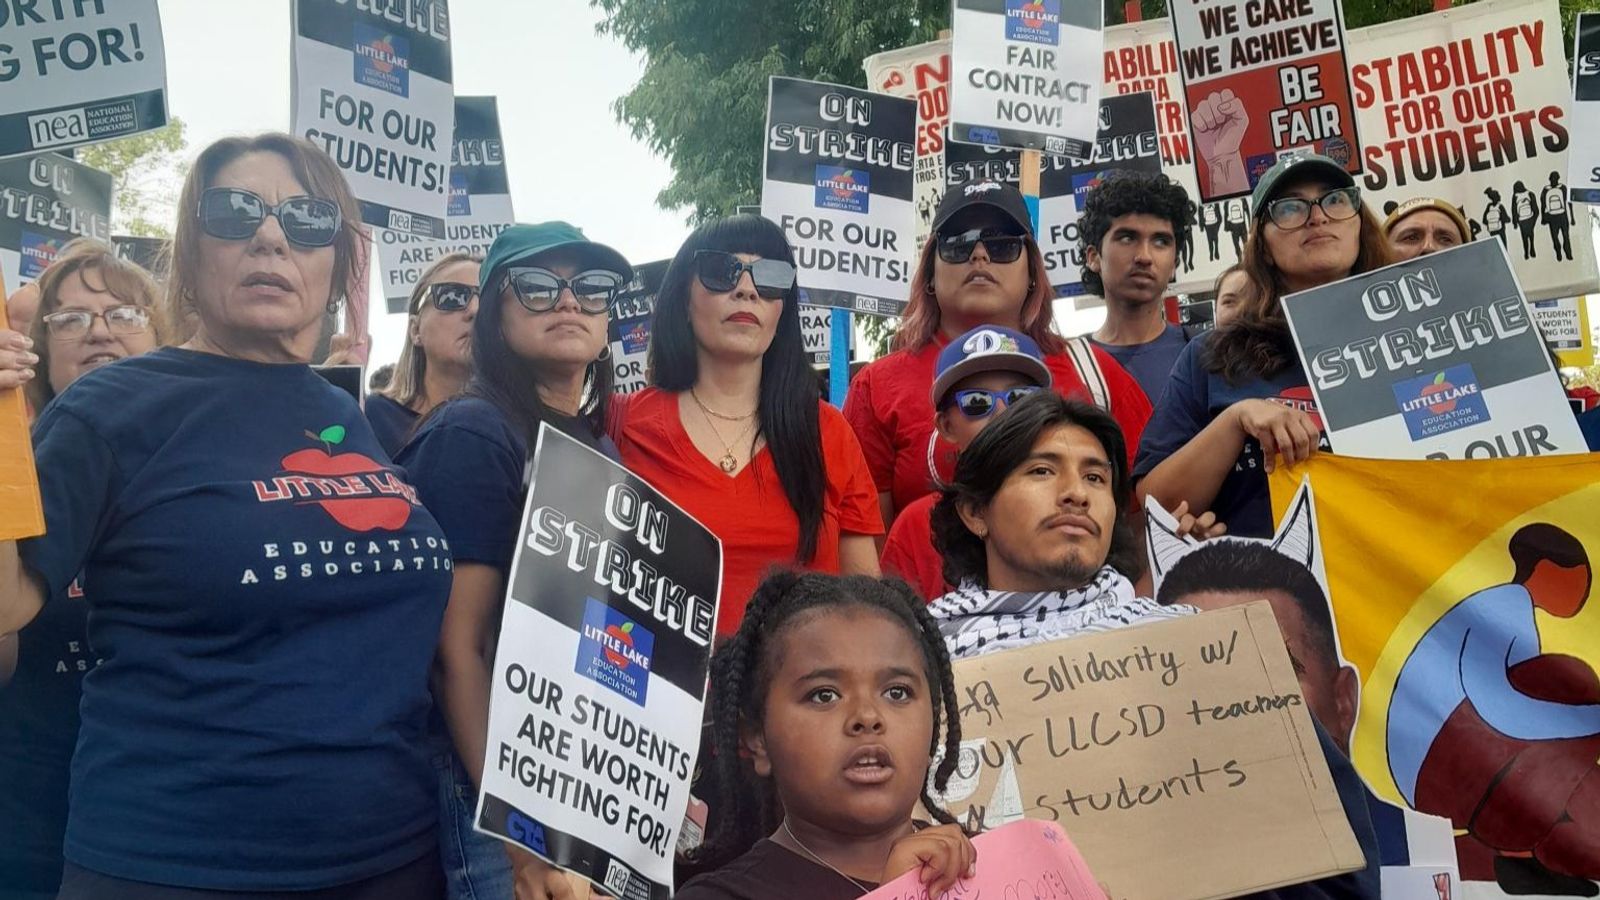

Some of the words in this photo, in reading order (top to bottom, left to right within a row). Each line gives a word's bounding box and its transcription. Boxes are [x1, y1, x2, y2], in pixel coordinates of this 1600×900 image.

[1007, 8, 1036, 20] LITTLE
[1036, 12, 1059, 23] LAKE
[1015, 26, 1049, 37] EDUCATION
[1199, 5, 1240, 40] WE
[32, 23, 144, 76] FOR!
[1012, 33, 1052, 44] ASSOCIATION
[1182, 45, 1222, 80] WE
[1231, 19, 1337, 69] ACHIEVE
[355, 43, 385, 61] LITTLE
[386, 52, 408, 69] LAKE
[1006, 45, 1057, 71] FAIR
[1351, 19, 1544, 109] STABILITY
[968, 68, 1091, 104] CONTRACT
[1279, 64, 1323, 107] BE
[87, 105, 132, 118] NATIONAL
[88, 112, 134, 127] EDUCATION
[320, 88, 374, 134] FOR
[383, 109, 437, 152] OUR
[820, 93, 872, 126] ON
[996, 99, 1063, 128] NOW!
[1384, 95, 1444, 138] FOR
[1452, 78, 1516, 124] OUR
[34, 114, 84, 143] nea
[89, 121, 134, 135] ASSOCIATION
[1270, 103, 1342, 148] FAIR
[770, 123, 914, 171] STRIKE
[1363, 105, 1569, 191] STUDENTS
[29, 158, 74, 195] ON
[817, 179, 844, 190] LITTLE
[846, 182, 869, 193] LAKE
[0, 187, 109, 242] TRIKE
[822, 201, 862, 212] ASSOCIATION
[825, 195, 860, 205] EDUCATION
[781, 214, 836, 242] FOR
[842, 222, 898, 252] OUR
[22, 247, 48, 259] LITTLE
[399, 247, 434, 264] ARE
[1362, 267, 1442, 321] ON
[1537, 310, 1577, 319] STUDENTS
[1542, 319, 1571, 327] WORTH
[1312, 295, 1531, 390] STRIKE
[1402, 393, 1443, 412] LITTLE
[1444, 383, 1478, 399] LAKE
[1421, 407, 1472, 426] EDUCATION
[1421, 414, 1480, 436] ASSOCIATION
[1465, 424, 1558, 460] OUR
[252, 475, 371, 502] LITTLE
[605, 482, 668, 555] ON
[264, 537, 449, 558] EDUCATION
[241, 557, 454, 584] ASSOCIATIO
[527, 505, 714, 647] STRIKE
[585, 624, 621, 653] LITTLE
[622, 641, 649, 670] LAKE
[1200, 630, 1238, 665] w/
[586, 667, 638, 699] ASSOCIATION
[592, 656, 636, 685] EDUCATION
[505, 663, 563, 716] OUR
[571, 694, 690, 781] STUDENTS
[1046, 704, 1165, 758] LLCSD
[1186, 693, 1302, 725] teachers
[517, 713, 573, 762] ARE
[581, 738, 670, 811] WORTH
[498, 741, 620, 826] FIGHTING
[625, 805, 671, 858] FOR!
[506, 811, 547, 856] CTA
[606, 865, 627, 892] nea
